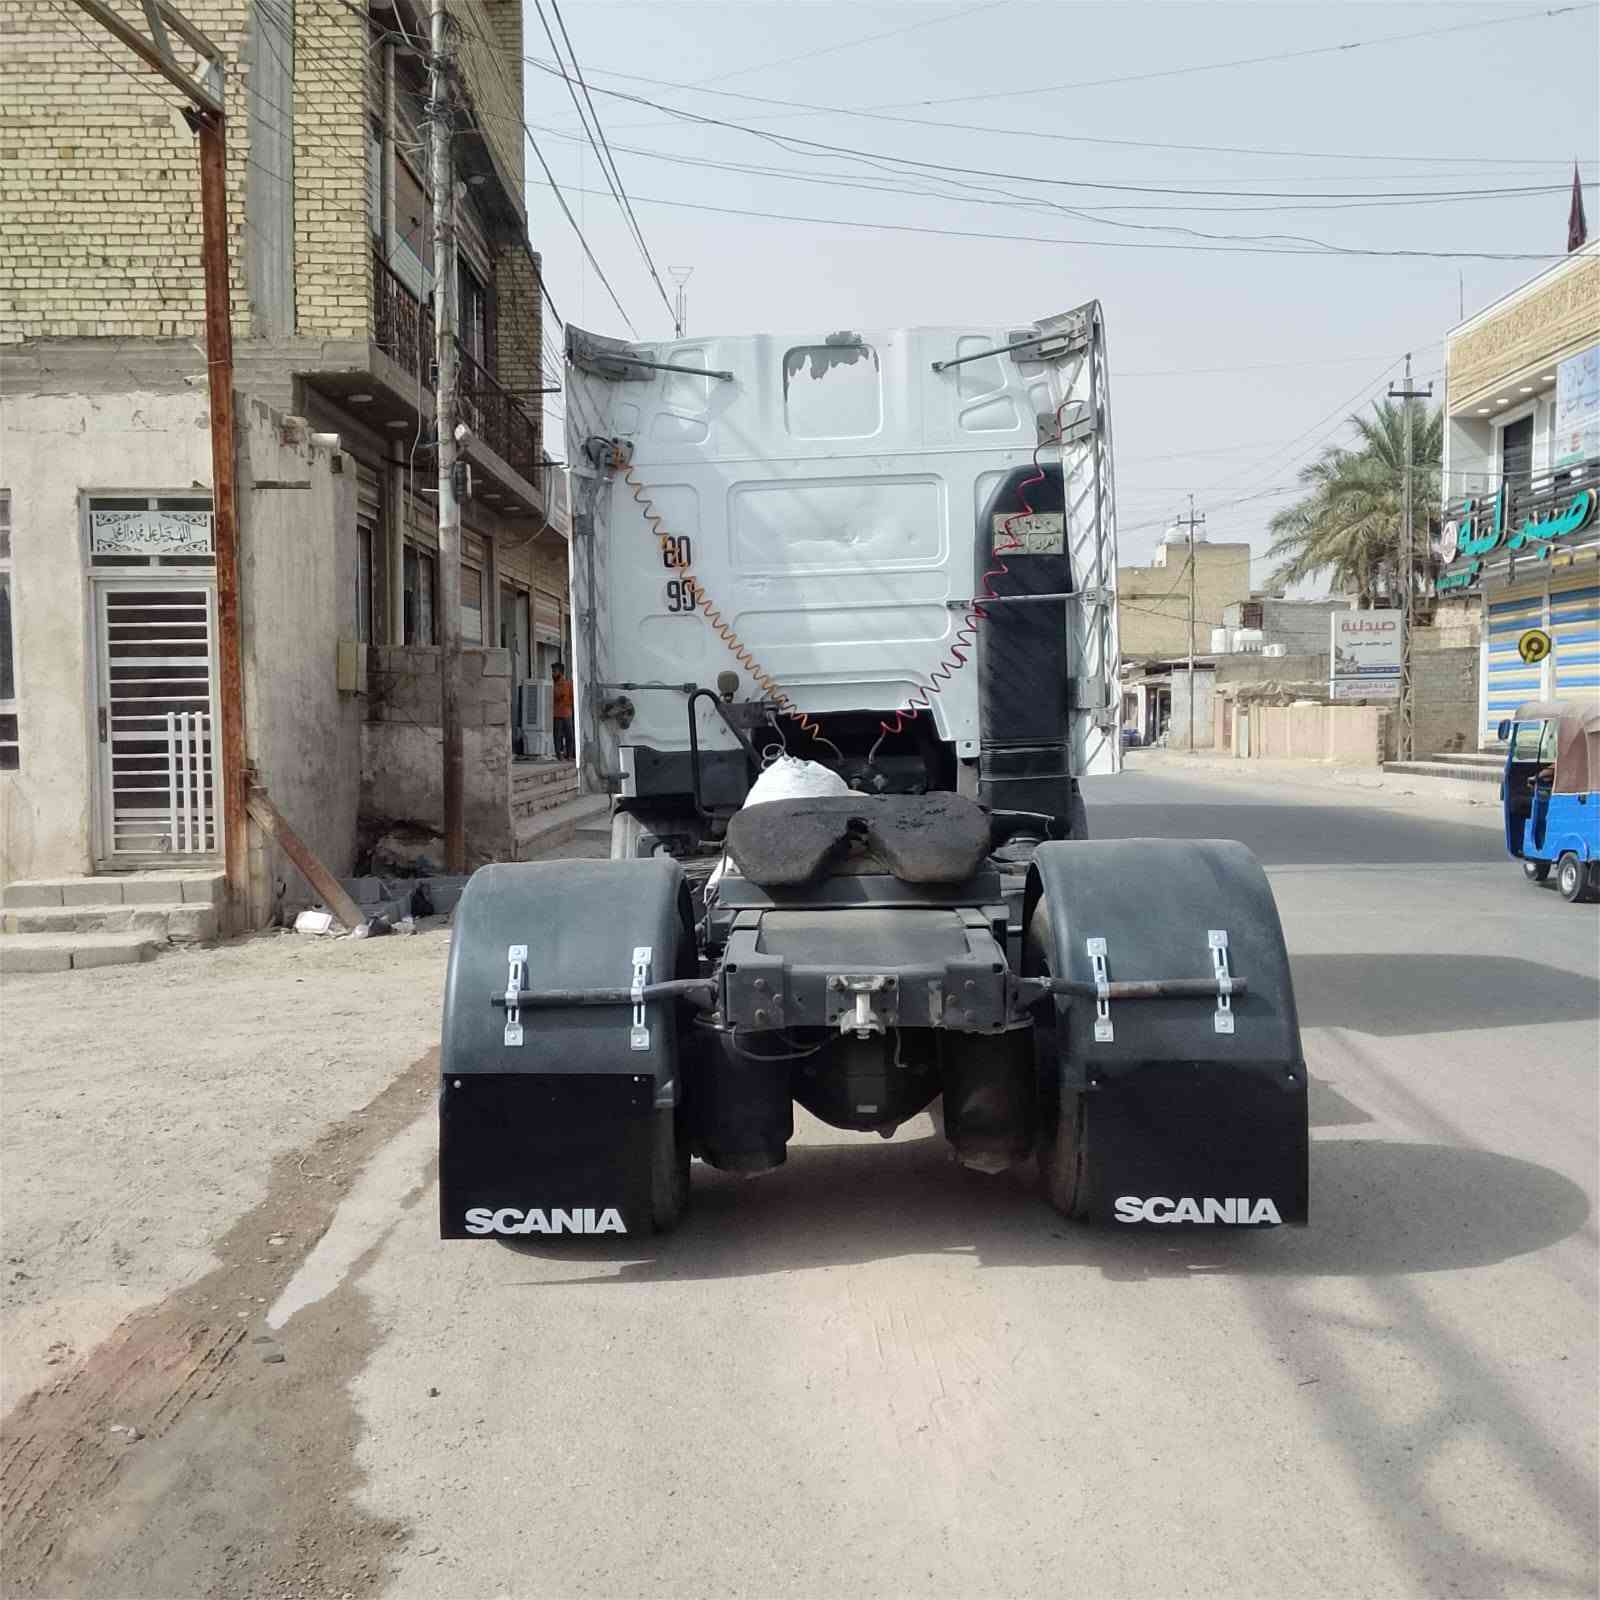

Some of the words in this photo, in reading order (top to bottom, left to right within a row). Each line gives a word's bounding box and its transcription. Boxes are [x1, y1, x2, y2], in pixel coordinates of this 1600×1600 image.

[663, 536, 691, 568] 80
[667, 579, 696, 612] 90
[1342, 619, 1396, 635] صيدلية
[465, 1207, 628, 1235] SCANIA
[1114, 1196, 1282, 1225] SCANIA
